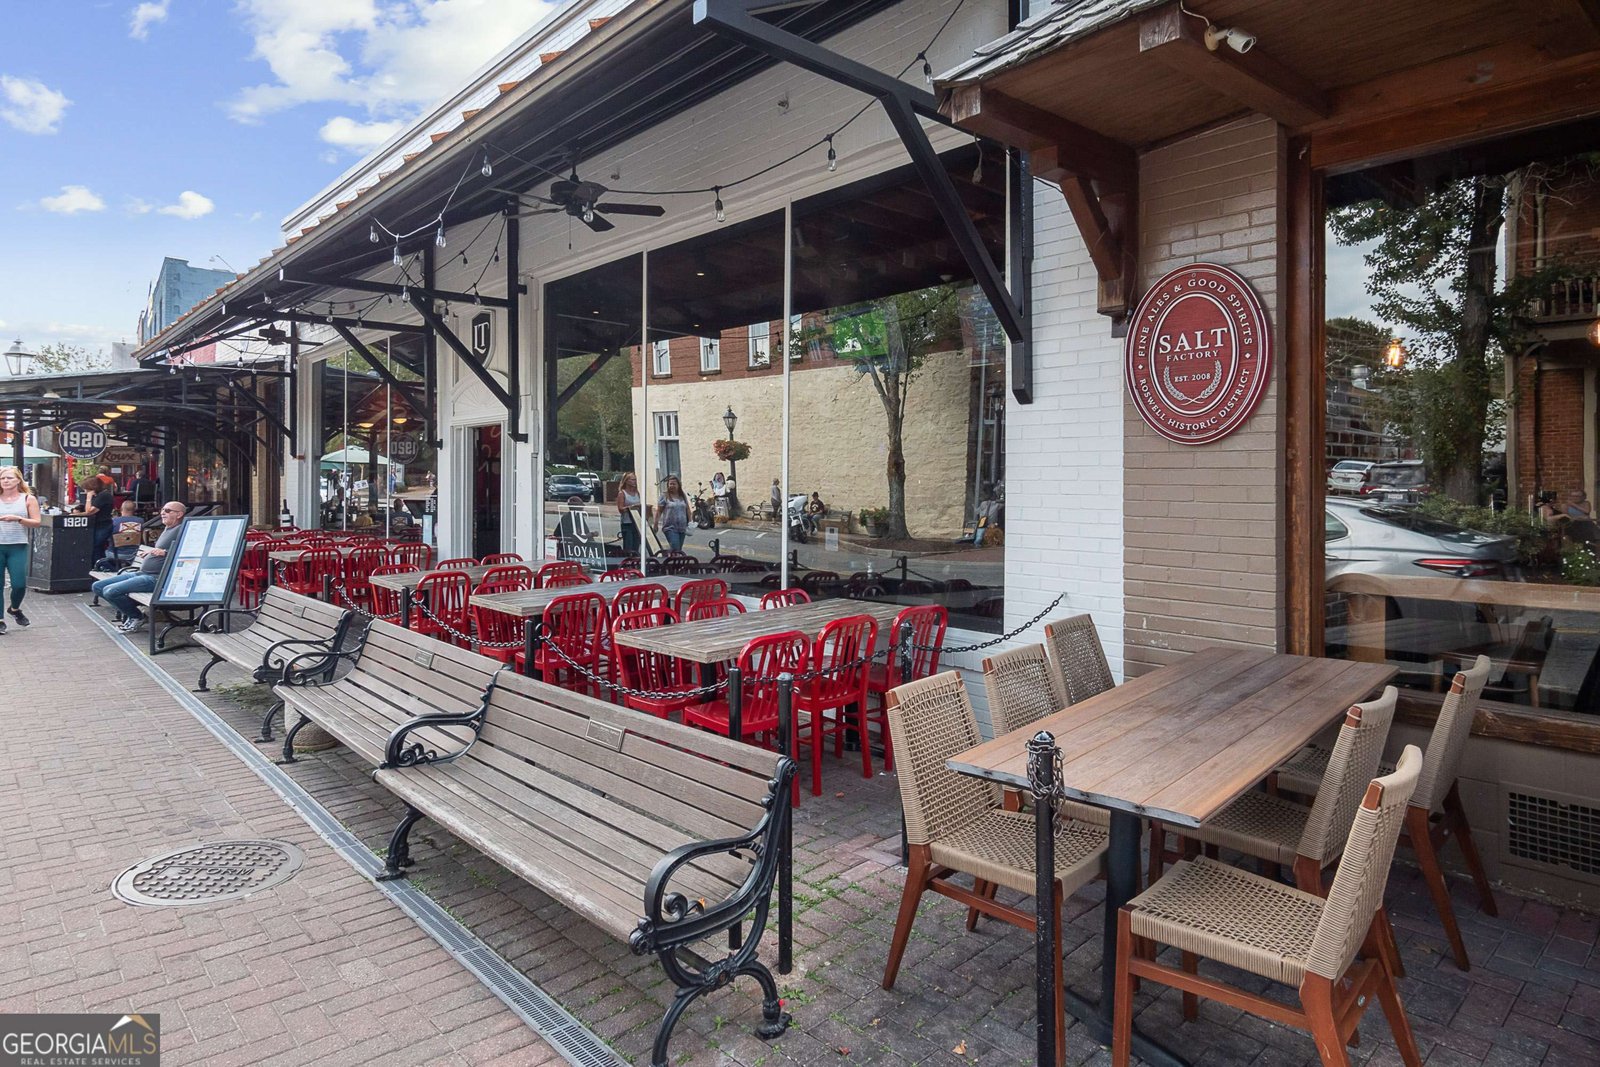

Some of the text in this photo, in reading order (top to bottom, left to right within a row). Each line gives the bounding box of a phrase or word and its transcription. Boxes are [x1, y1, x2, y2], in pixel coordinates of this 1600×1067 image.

[1138, 279, 1253, 357] FINE ALES & GOOD SPIRITS
[1159, 327, 1228, 354] SALT
[1166, 350, 1219, 362] FACTORY
[1174, 372, 1211, 383] EST. 2008
[1139, 368, 1250, 431] ROSWELL HISTORIC DISTRICT
[63, 431, 104, 448] 1920
[101, 450, 135, 463] Roux
[64, 517, 88, 527] 1920
[567, 545, 600, 559] LOYAL
[177, 867, 255, 876] STORM
